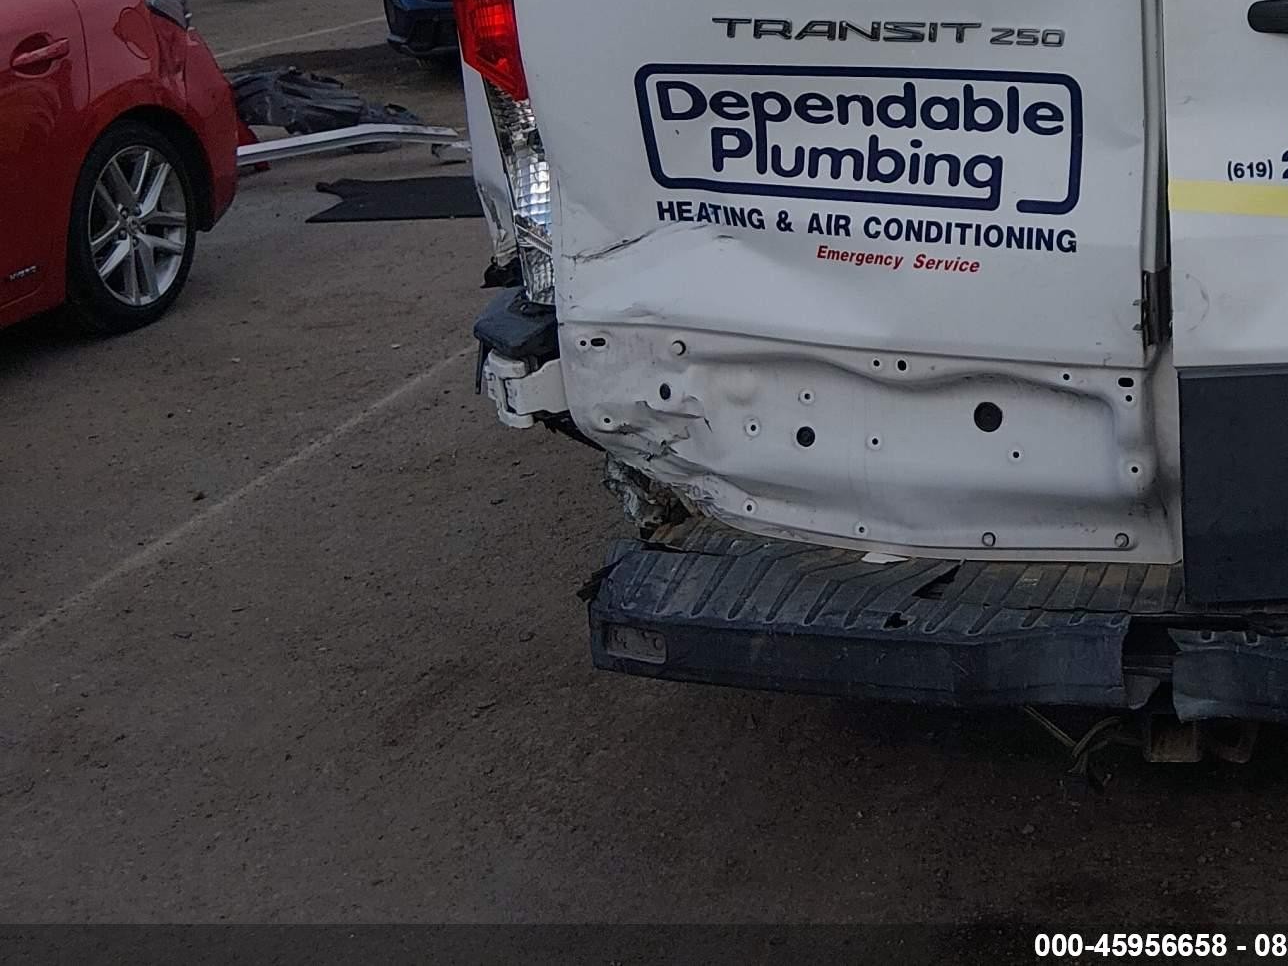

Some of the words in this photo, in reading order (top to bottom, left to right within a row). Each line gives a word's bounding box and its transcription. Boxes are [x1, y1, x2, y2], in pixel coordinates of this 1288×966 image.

[711, 17, 982, 44] TRANSIT
[990, 27, 1066, 48] 250
[655, 80, 1066, 136] Dependable
[711, 127, 1003, 194] Plumbing
[1227, 158, 1273, 182] (619)
[656, 200, 766, 231] HEATING
[776, 210, 795, 233] &
[807, 212, 852, 238] AIR
[863, 216, 1078, 254] CONDITIONING
[815, 245, 903, 271] Emergency
[912, 253, 981, 274] Service
